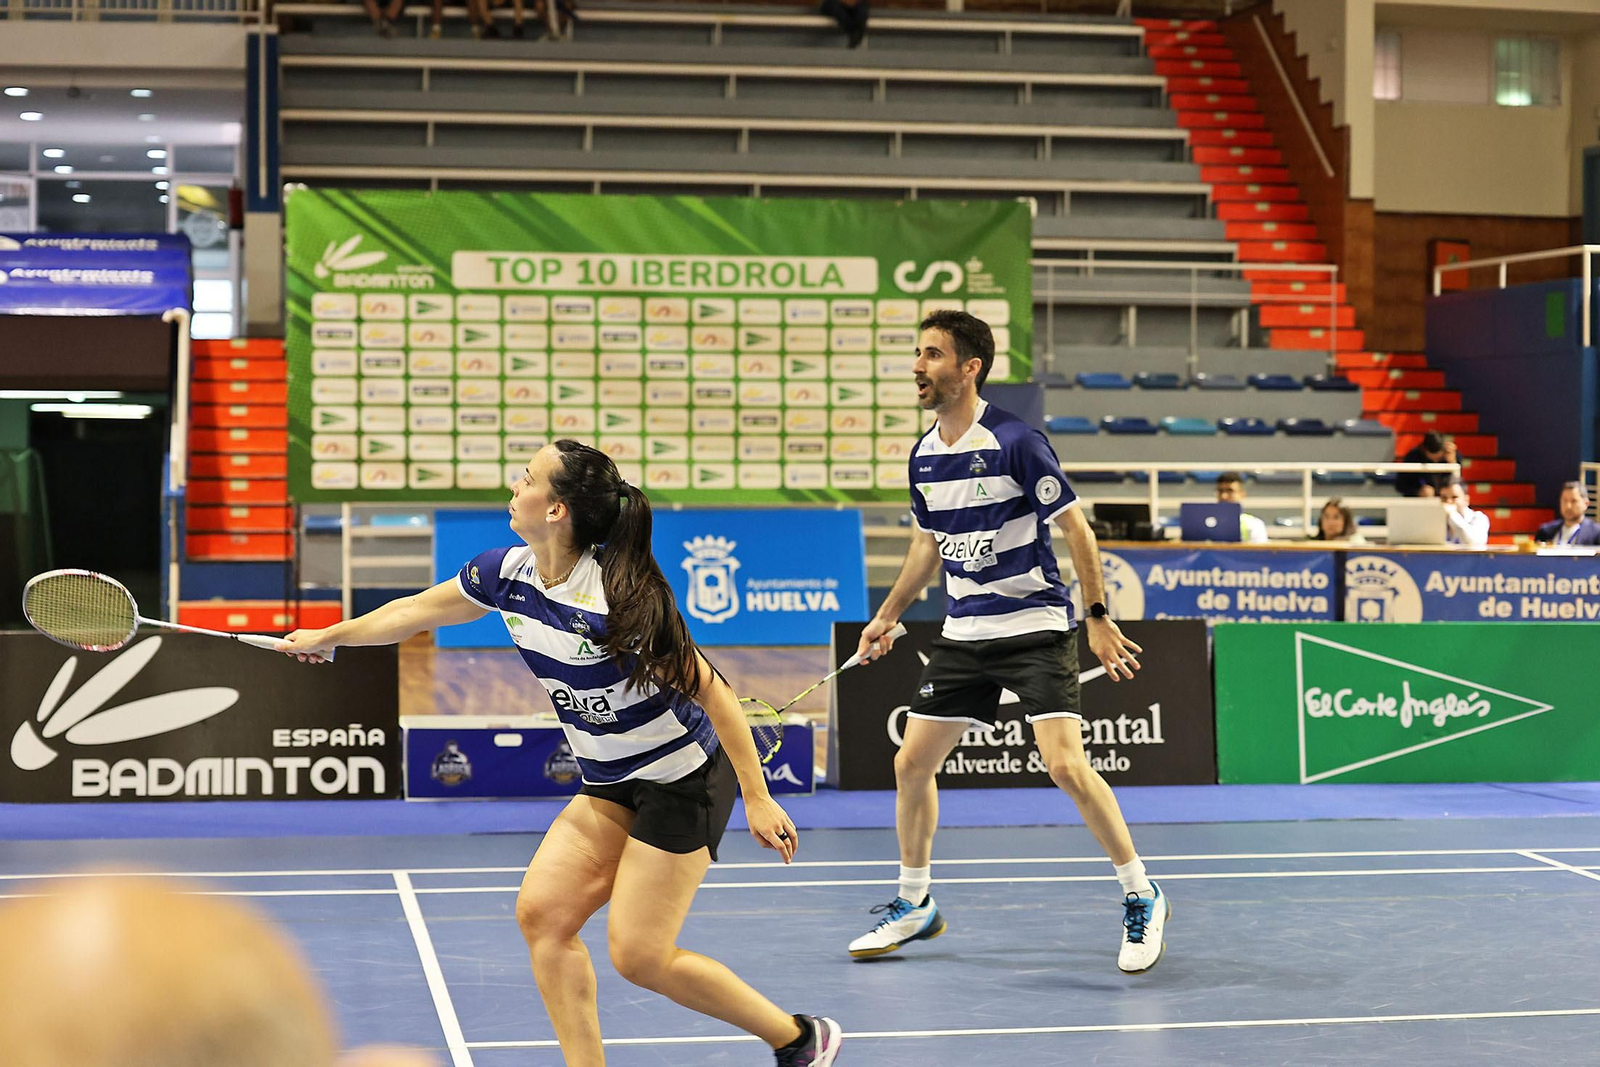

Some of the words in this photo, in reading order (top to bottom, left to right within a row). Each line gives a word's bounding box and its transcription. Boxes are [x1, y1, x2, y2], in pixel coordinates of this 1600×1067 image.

[487, 257, 562, 284] TOP
[576, 260, 617, 285] 10
[631, 260, 845, 289] IBERDROLA
[746, 577, 819, 591] Ayuntamiento
[823, 578, 838, 589] de
[1147, 565, 1329, 591] Ayuntamiento
[1425, 571, 1600, 597] Ayuntamient
[746, 591, 840, 611] HUELVA
[1197, 590, 1230, 609] de
[1236, 591, 1329, 612] Huelva
[1478, 596, 1513, 618] de
[1520, 597, 1600, 619] Huelv
[547, 686, 612, 714] elva
[1305, 687, 1334, 718] El
[1334, 688, 1398, 718] Corte
[1400, 680, 1491, 728] Inglés
[272, 723, 386, 748] ESPAÑA
[1080, 703, 1166, 745] ental
[937, 751, 1023, 775] alverde
[72, 756, 386, 797] BADMINTON
